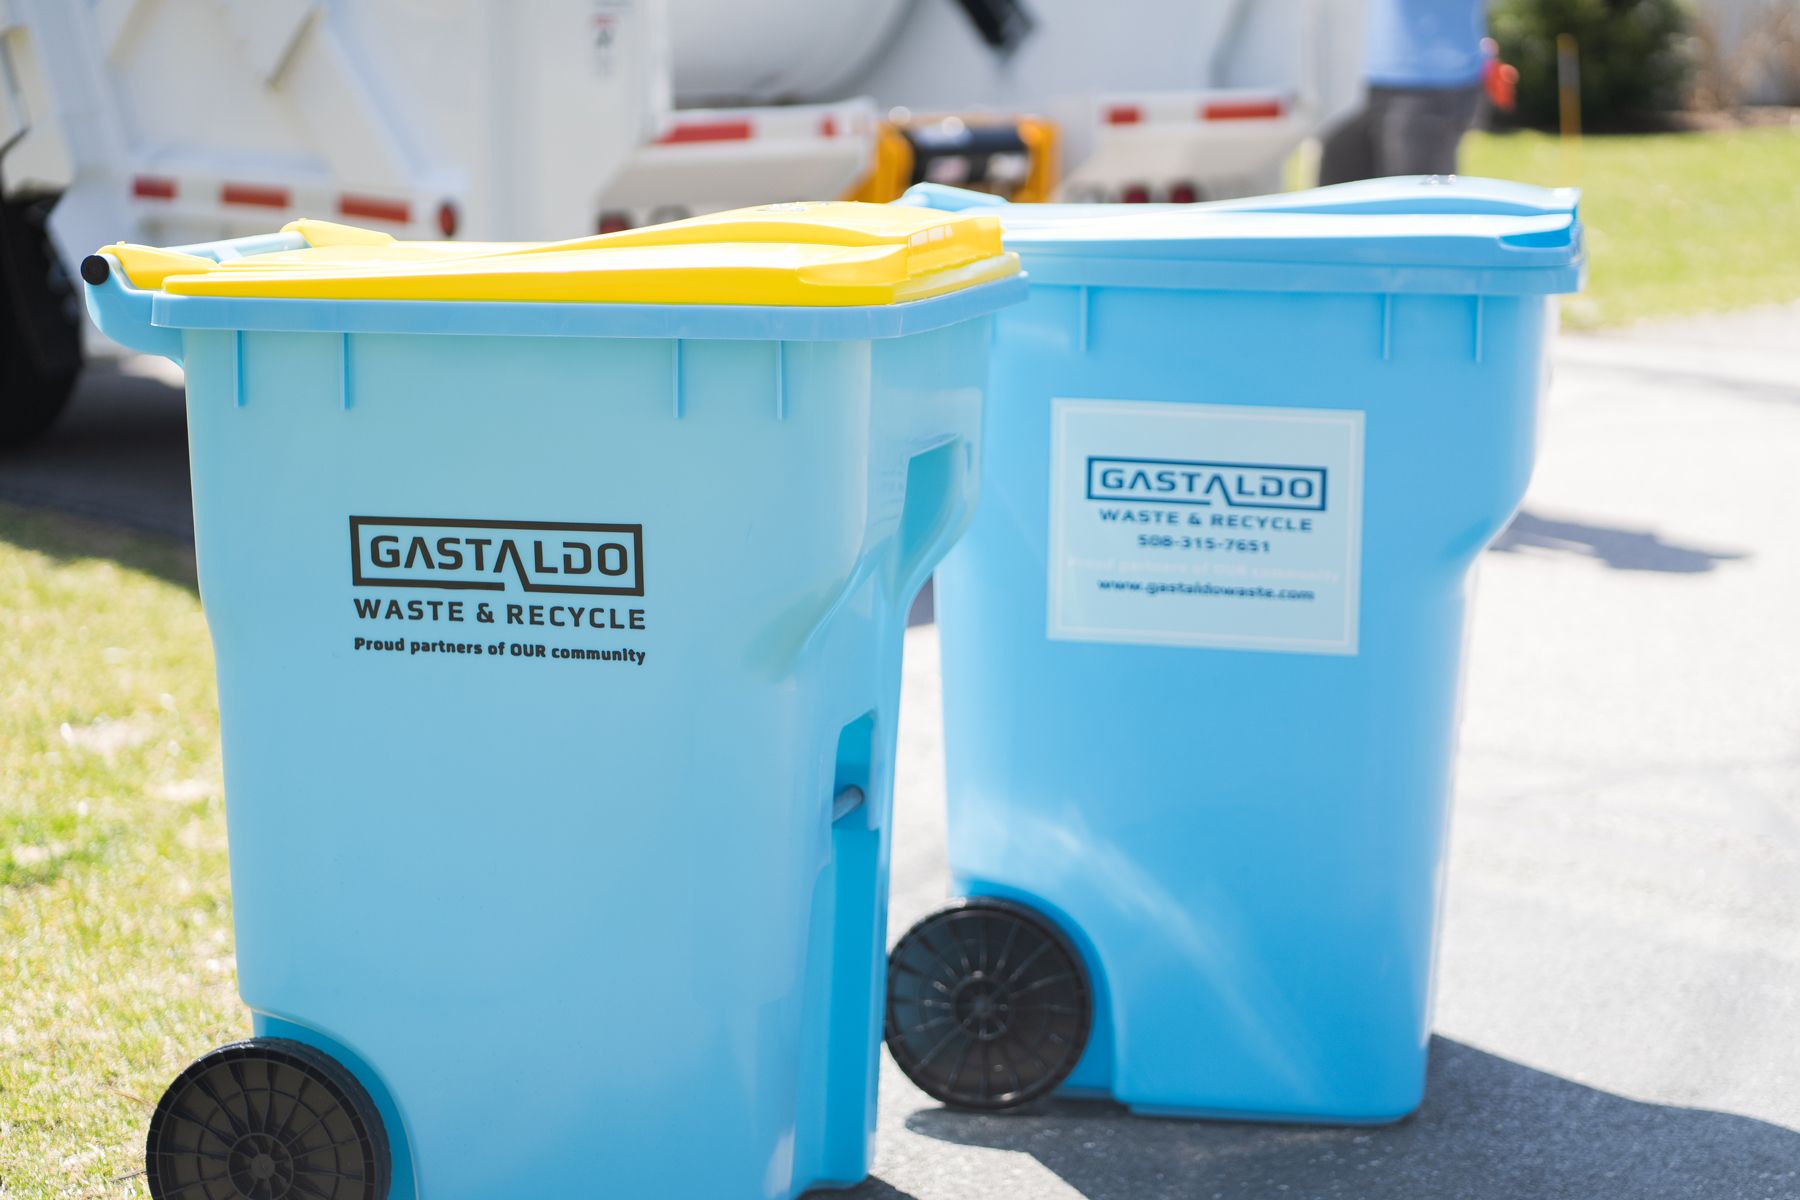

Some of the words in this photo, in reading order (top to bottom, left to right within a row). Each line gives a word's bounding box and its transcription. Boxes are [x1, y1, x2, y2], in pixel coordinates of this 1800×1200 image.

[1101, 468, 1313, 499] GASTALDO
[1099, 509, 1179, 525] WASTE
[1186, 512, 1202, 526] &
[1210, 512, 1313, 532] RECYCLE
[370, 535, 628, 577] GASTALDO
[1137, 535, 1271, 553] 508-315-7651
[1097, 580, 1315, 600] www.gastaldowaste.com
[353, 598, 464, 622] WASTE
[477, 603, 494, 623] &
[507, 604, 645, 630] RECYCLE
[354, 637, 404, 651] Proud
[411, 640, 482, 655] partners
[488, 642, 505, 656] of
[510, 643, 546, 658] OUR
[552, 648, 646, 666] community
